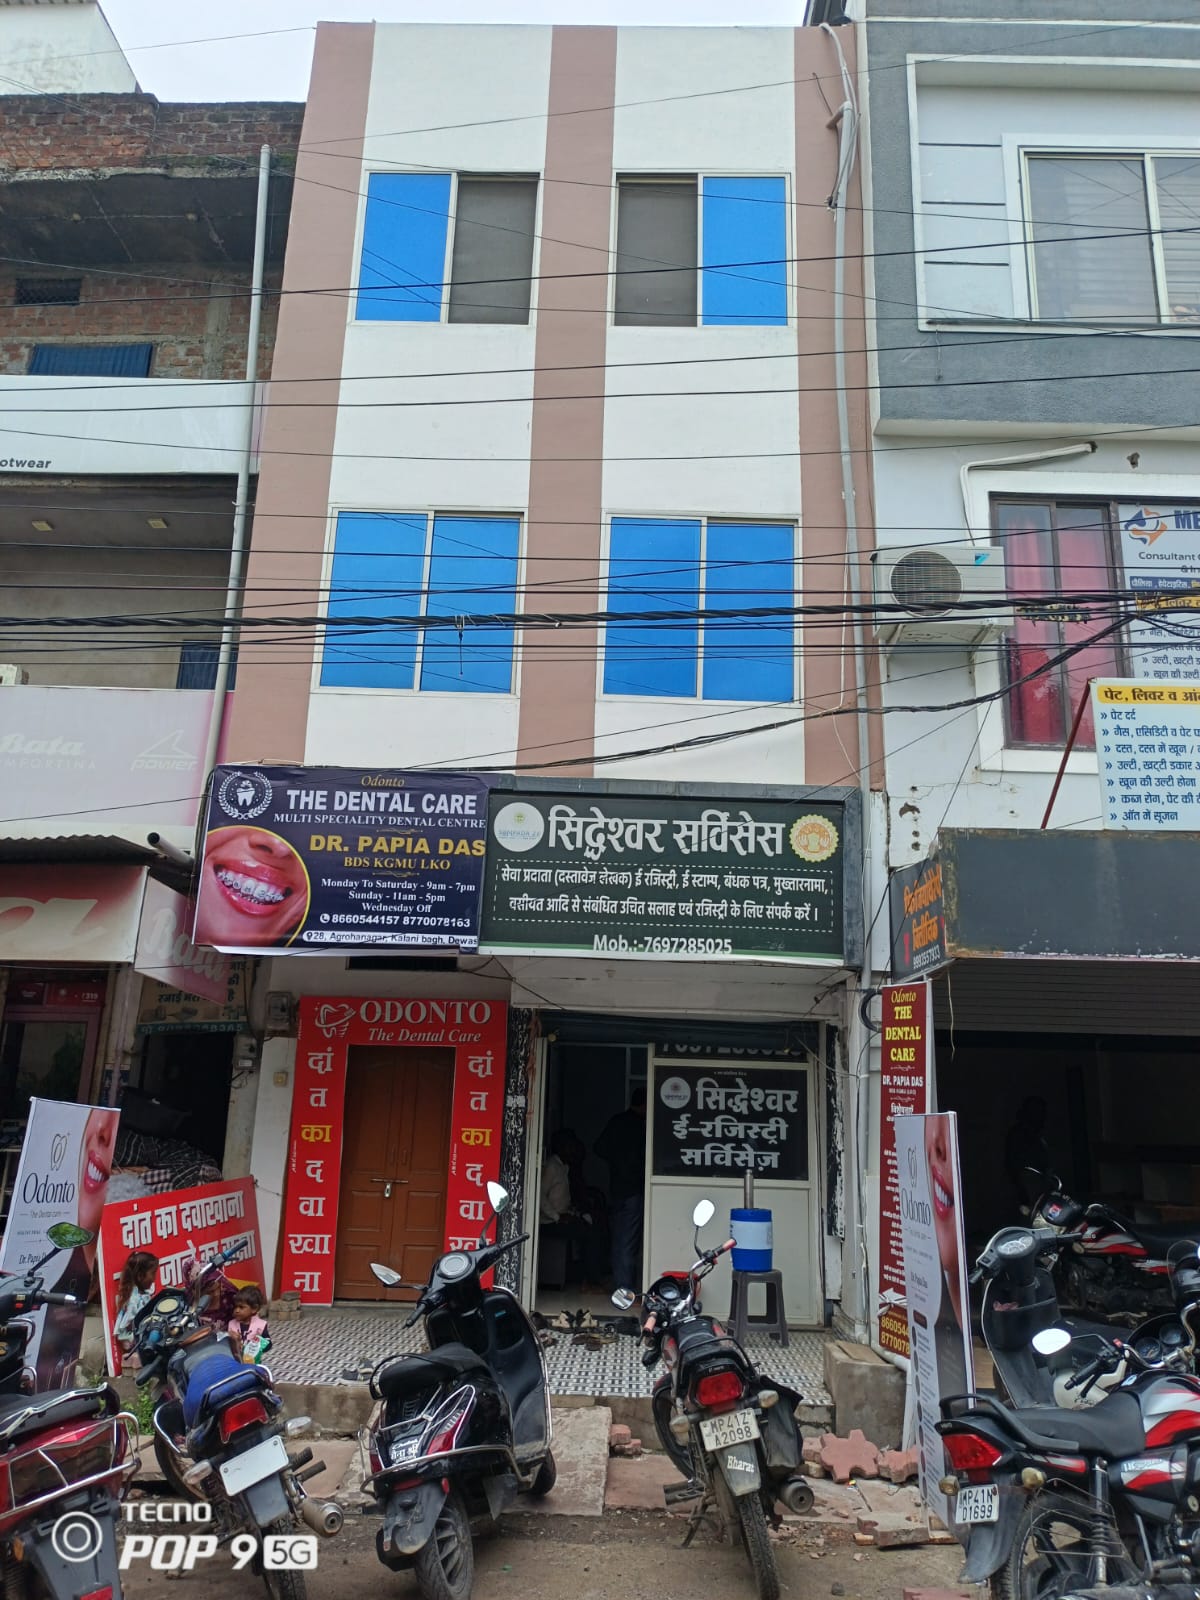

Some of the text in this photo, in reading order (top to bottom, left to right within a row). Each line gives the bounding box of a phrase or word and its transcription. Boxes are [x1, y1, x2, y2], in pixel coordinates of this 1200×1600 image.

[1138, 551, 1196, 561] Consultant
[1110, 707, 1136, 720] पेट दर्द
[361, 775, 405, 788] Odonto
[286, 790, 477, 815] THE DENTAL CARE
[273, 813, 486, 829] MULTI SPECIALITY DENTAL CENTRE
[673, 809, 786, 857] सर्विसेस
[311, 834, 487, 856] DR. PAPIA DAS
[344, 857, 451, 870] BDS KGMU LKO
[501, 863, 522, 882] सेवा
[523, 868, 552, 883] प्रदाता
[635, 868, 643, 887] ई
[723, 871, 751, 889] बंधक
[321, 878, 360, 889] Monday
[362, 879, 373, 888] To
[375, 880, 419, 891] Saturday
[426, 882, 446, 891] 9am
[455, 883, 476, 893] 7pm
[348, 891, 384, 902] Sunday
[393, 892, 417, 901] 11am
[425, 893, 446, 903] 5pm
[361, 903, 433, 914] Wednesday Off
[509, 893, 545, 912] वसीयत
[546, 894, 569, 912] आदि
[571, 894, 580, 912] से
[582, 895, 618, 914] संबंधित
[620, 896, 645, 915] उचित
[647, 901, 677, 917] सलाह
[678, 899, 693, 916] एवं
[695, 898, 728, 920] रजिस्ट्री
[729, 900, 741, 918] के
[743, 900, 764, 919] लिए
[765, 901, 792, 920] संपर्क
[794, 902, 811, 920] करें
[331, 914, 471, 928] 8660544157 8770078163
[312, 931, 327, 941] 28,
[391, 933, 419, 943] Kalani
[448, 936, 478, 946] Dewas
[359, 1000, 492, 1025] ODONTO
[893, 1006, 913, 1020] THE
[368, 1027, 482, 1042] The Dental Care
[885, 1026, 922, 1041] DENTAL
[890, 1048, 915, 1062] CARE
[892, 1074, 910, 1086] PAPIA
[911, 1075, 924, 1087] DAS
[696, 1077, 799, 1114] सिद्धेश्वर
[23, 1172, 75, 1205] Odonto
[901, 1187, 931, 1227] Odonto
[120, 1190, 245, 1250] दांत का दवाखाना
[710, 1411, 750, 1435] MP41Z
[714, 1425, 753, 1448] A2098
[962, 1504, 993, 1522] D1699
